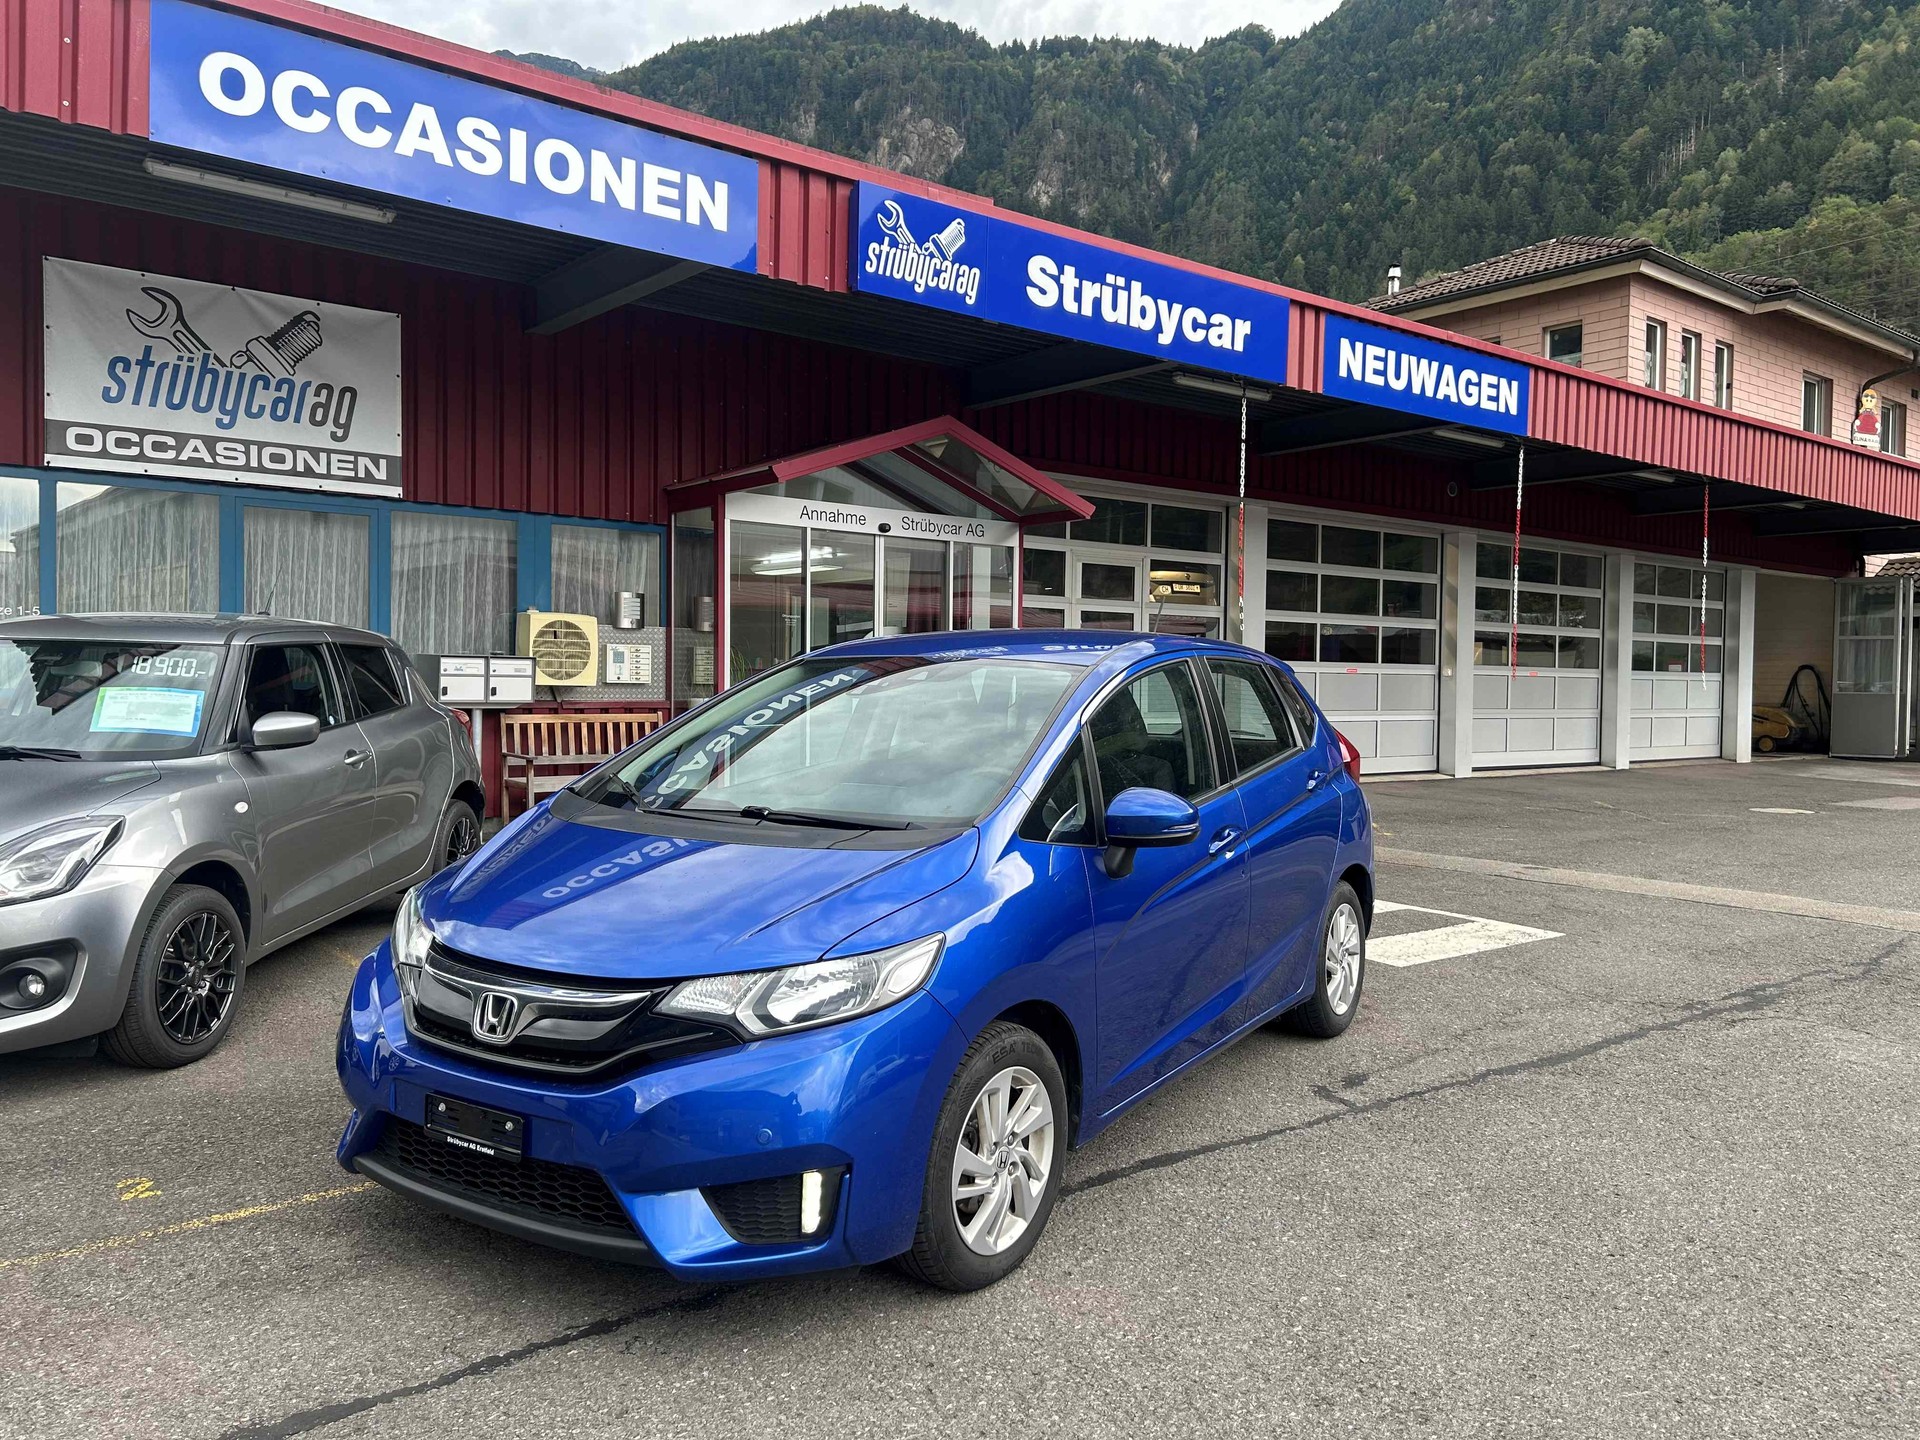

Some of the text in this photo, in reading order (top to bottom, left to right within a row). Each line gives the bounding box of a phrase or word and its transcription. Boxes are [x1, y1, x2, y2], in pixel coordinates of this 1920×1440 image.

[199, 51, 729, 232] OCCASIONEN
[865, 236, 980, 305] strübycarag
[1026, 254, 1252, 352] Strübycar
[101, 345, 357, 443] strübycarag
[1338, 337, 1519, 416] NEUWAGEN
[66, 426, 387, 481] OCCASIONEN
[800, 505, 867, 526] Annahme
[901, 516, 985, 538] Strübycar AG
[17, 605, 41, 616] 1-5
[116, 1177, 162, 1201] 2
